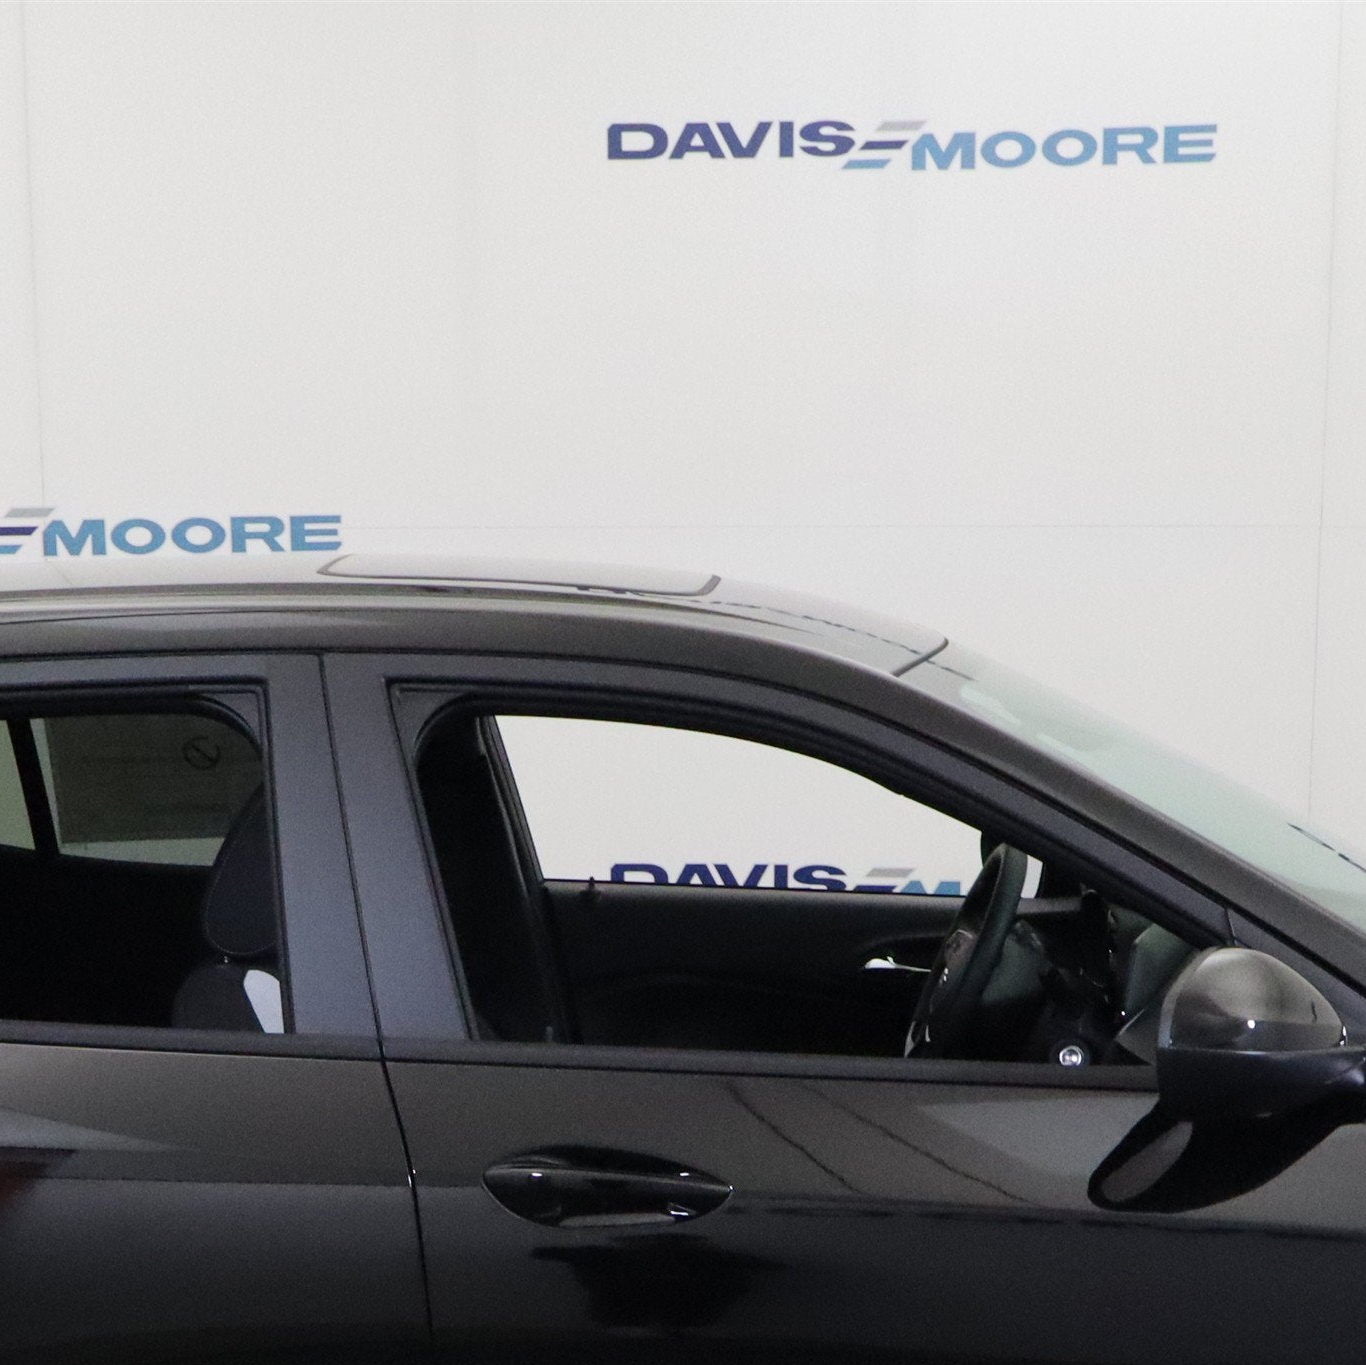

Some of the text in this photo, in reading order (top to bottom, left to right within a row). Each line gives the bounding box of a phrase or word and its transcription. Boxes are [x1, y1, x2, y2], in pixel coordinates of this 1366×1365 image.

[607, 120, 1218, 171] DAVIS MOORE
[43, 514, 343, 557] MOORE
